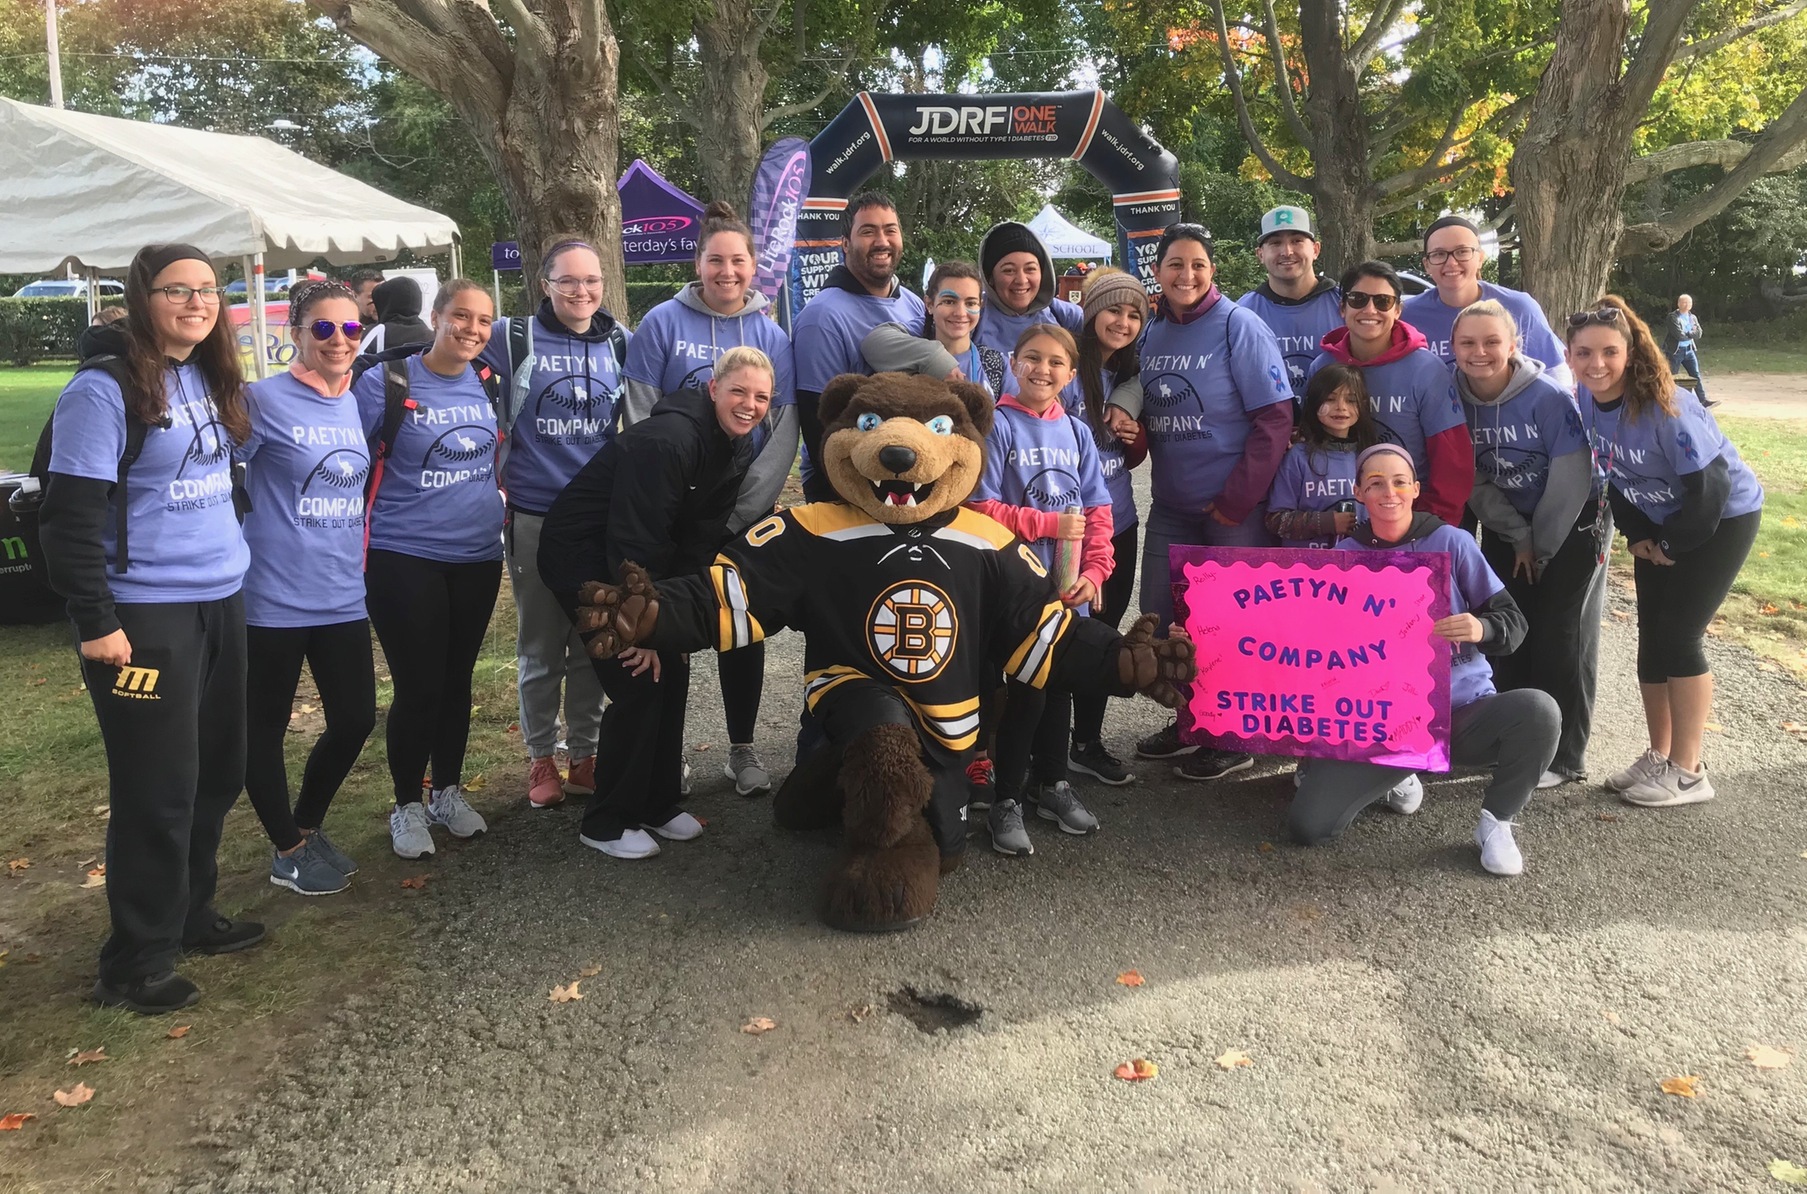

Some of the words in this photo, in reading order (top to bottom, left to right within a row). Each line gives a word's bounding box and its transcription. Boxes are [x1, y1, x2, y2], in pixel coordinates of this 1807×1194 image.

[908, 106, 1007, 135] JDRF
[1013, 105, 1056, 121] ONE
[1014, 121, 1056, 134] WALK
[1012, 134, 1045, 142] DIABETES
[825, 131, 872, 175] walk.jdrf.org
[1101, 128, 1145, 171] walk.jdrf.org
[797, 212, 822, 220] HANK
[823, 212, 840, 220] YOU
[1130, 206, 1161, 215] THANK
[1161, 203, 1176, 212] YOU
[623, 238, 677, 255] terday's
[1053, 244, 1098, 254] SCHOOL
[799, 251, 840, 266] YOUR
[536, 417, 612, 435] COMPANY
[1148, 415, 1204, 433] OMPANY
[292, 426, 360, 445] PAETYN
[535, 434, 562, 446] STRIKE
[566, 436, 581, 446] OUT
[1174, 429, 1213, 442] DIABETES
[1008, 447, 1072, 466] PAETYN
[169, 468, 233, 500] COMPAN
[167, 498, 206, 511] STRIKE
[299, 496, 364, 516] COMPAN
[293, 517, 328, 528] STRIKE
[332, 518, 346, 528] OUT
[1233, 577, 1349, 610] PAETYN
[1362, 593, 1396, 618] N'
[892, 602, 937, 660] B
[1237, 636, 1387, 671] COMPANY
[111, 688, 162, 700] SOFTBALL
[1217, 690, 1316, 714] STRIKE
[1335, 697, 1393, 721] OUT
[1242, 713, 1388, 743] DIABETES
